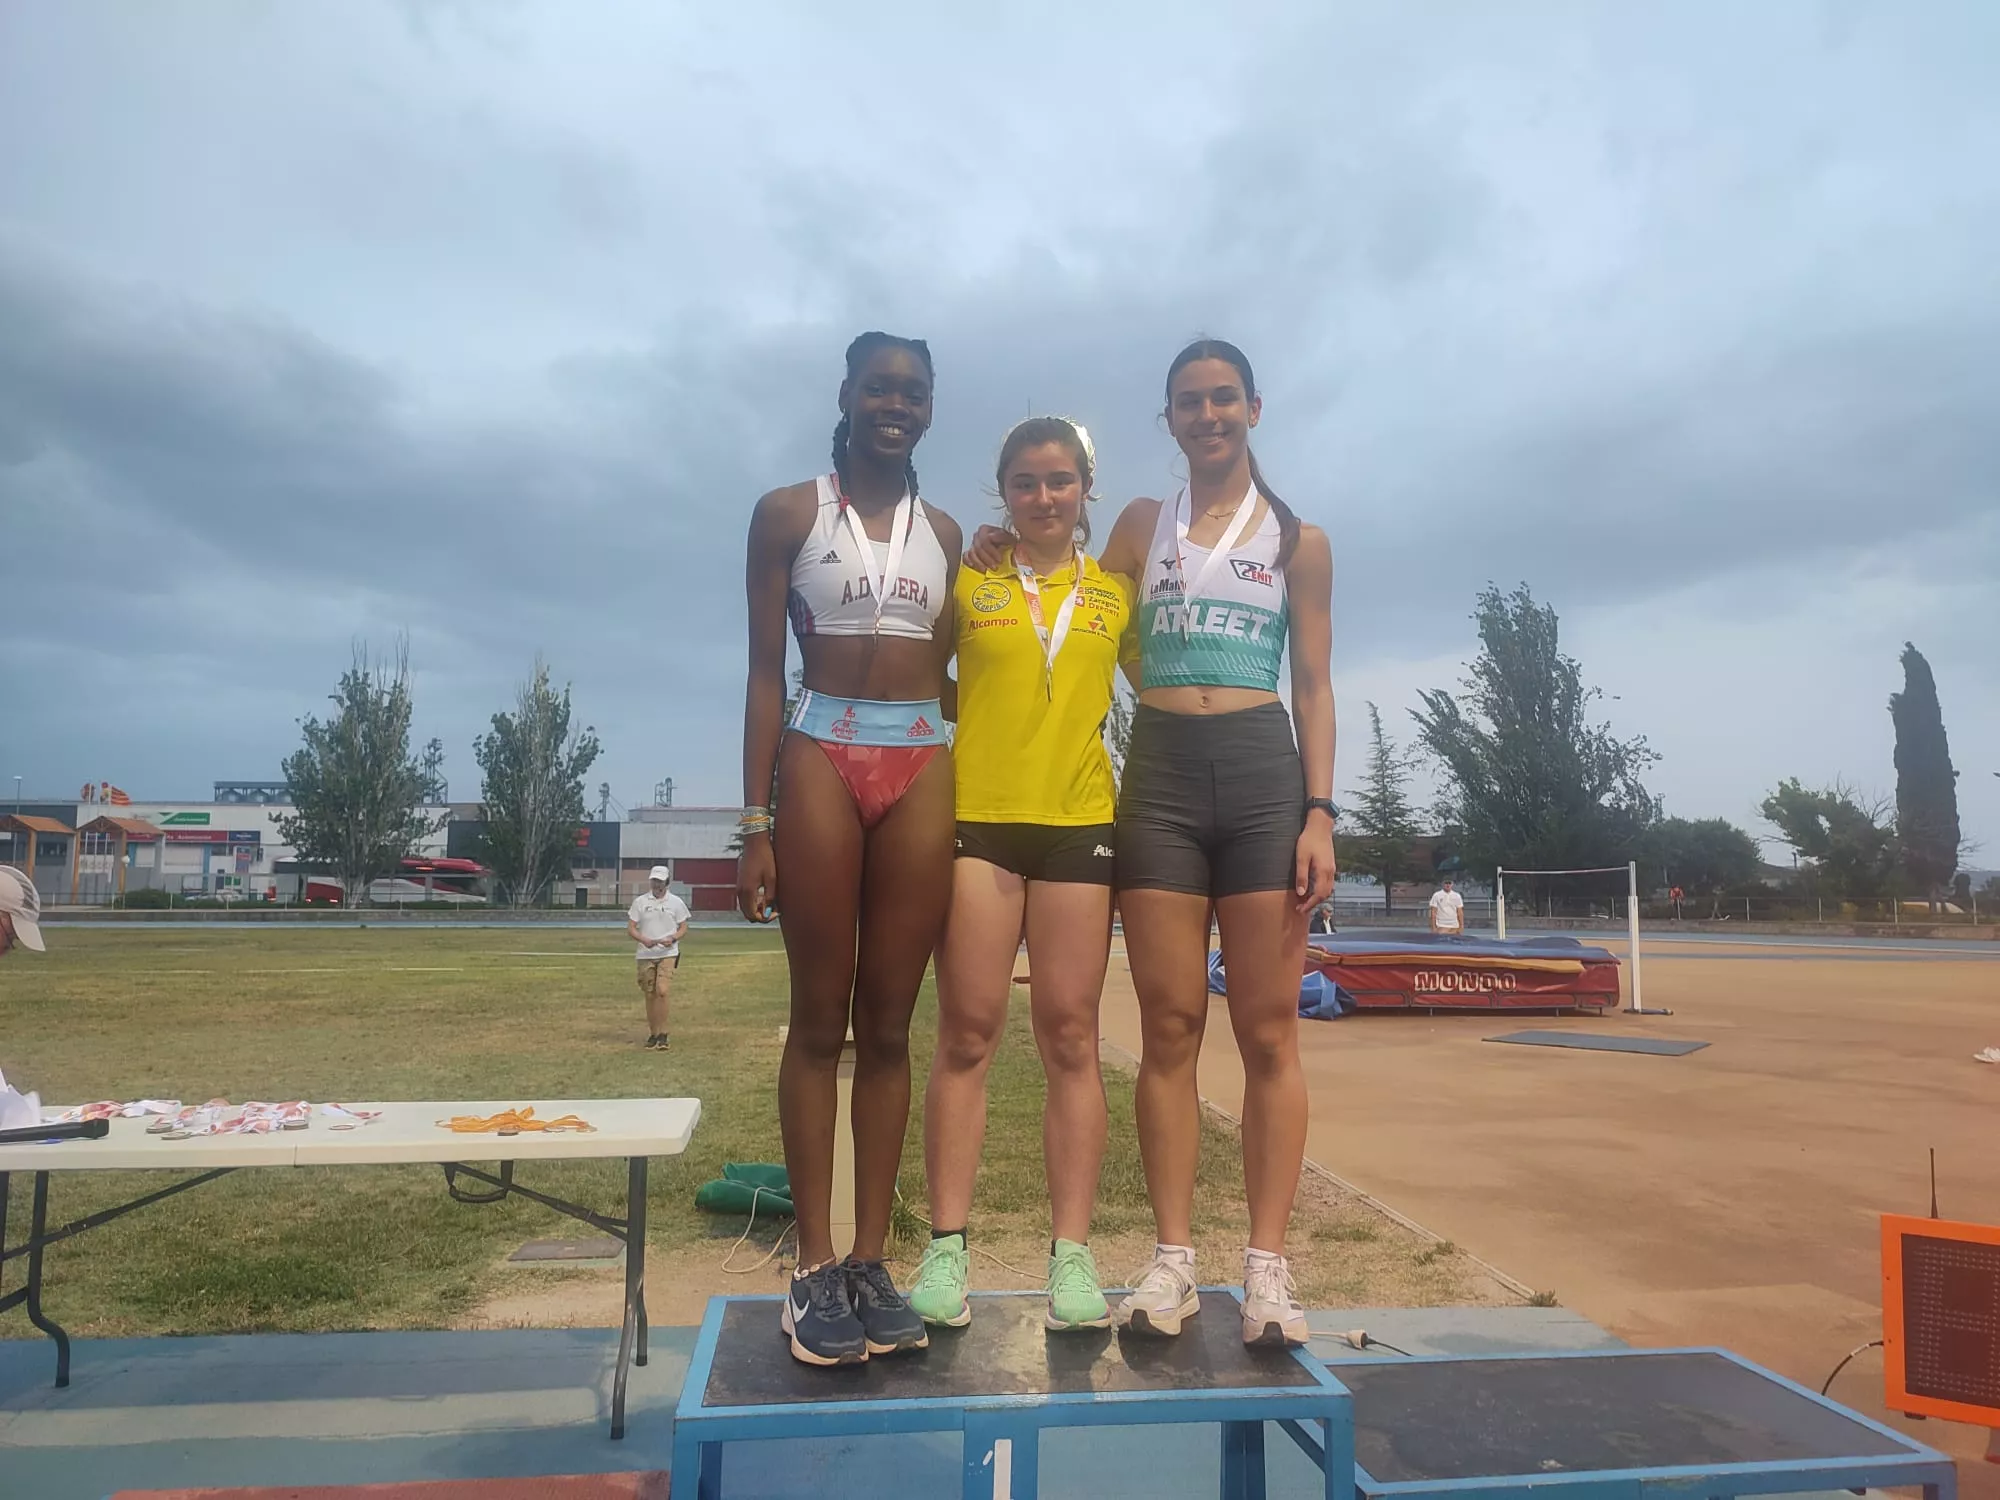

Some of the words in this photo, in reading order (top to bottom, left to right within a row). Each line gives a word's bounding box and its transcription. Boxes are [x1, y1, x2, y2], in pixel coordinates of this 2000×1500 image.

[968, 618, 1018, 633] Alcampo
[1151, 604, 1271, 641] ATLEET
[906, 727, 936, 738] adidas
[1414, 971, 1518, 993] MONDO
